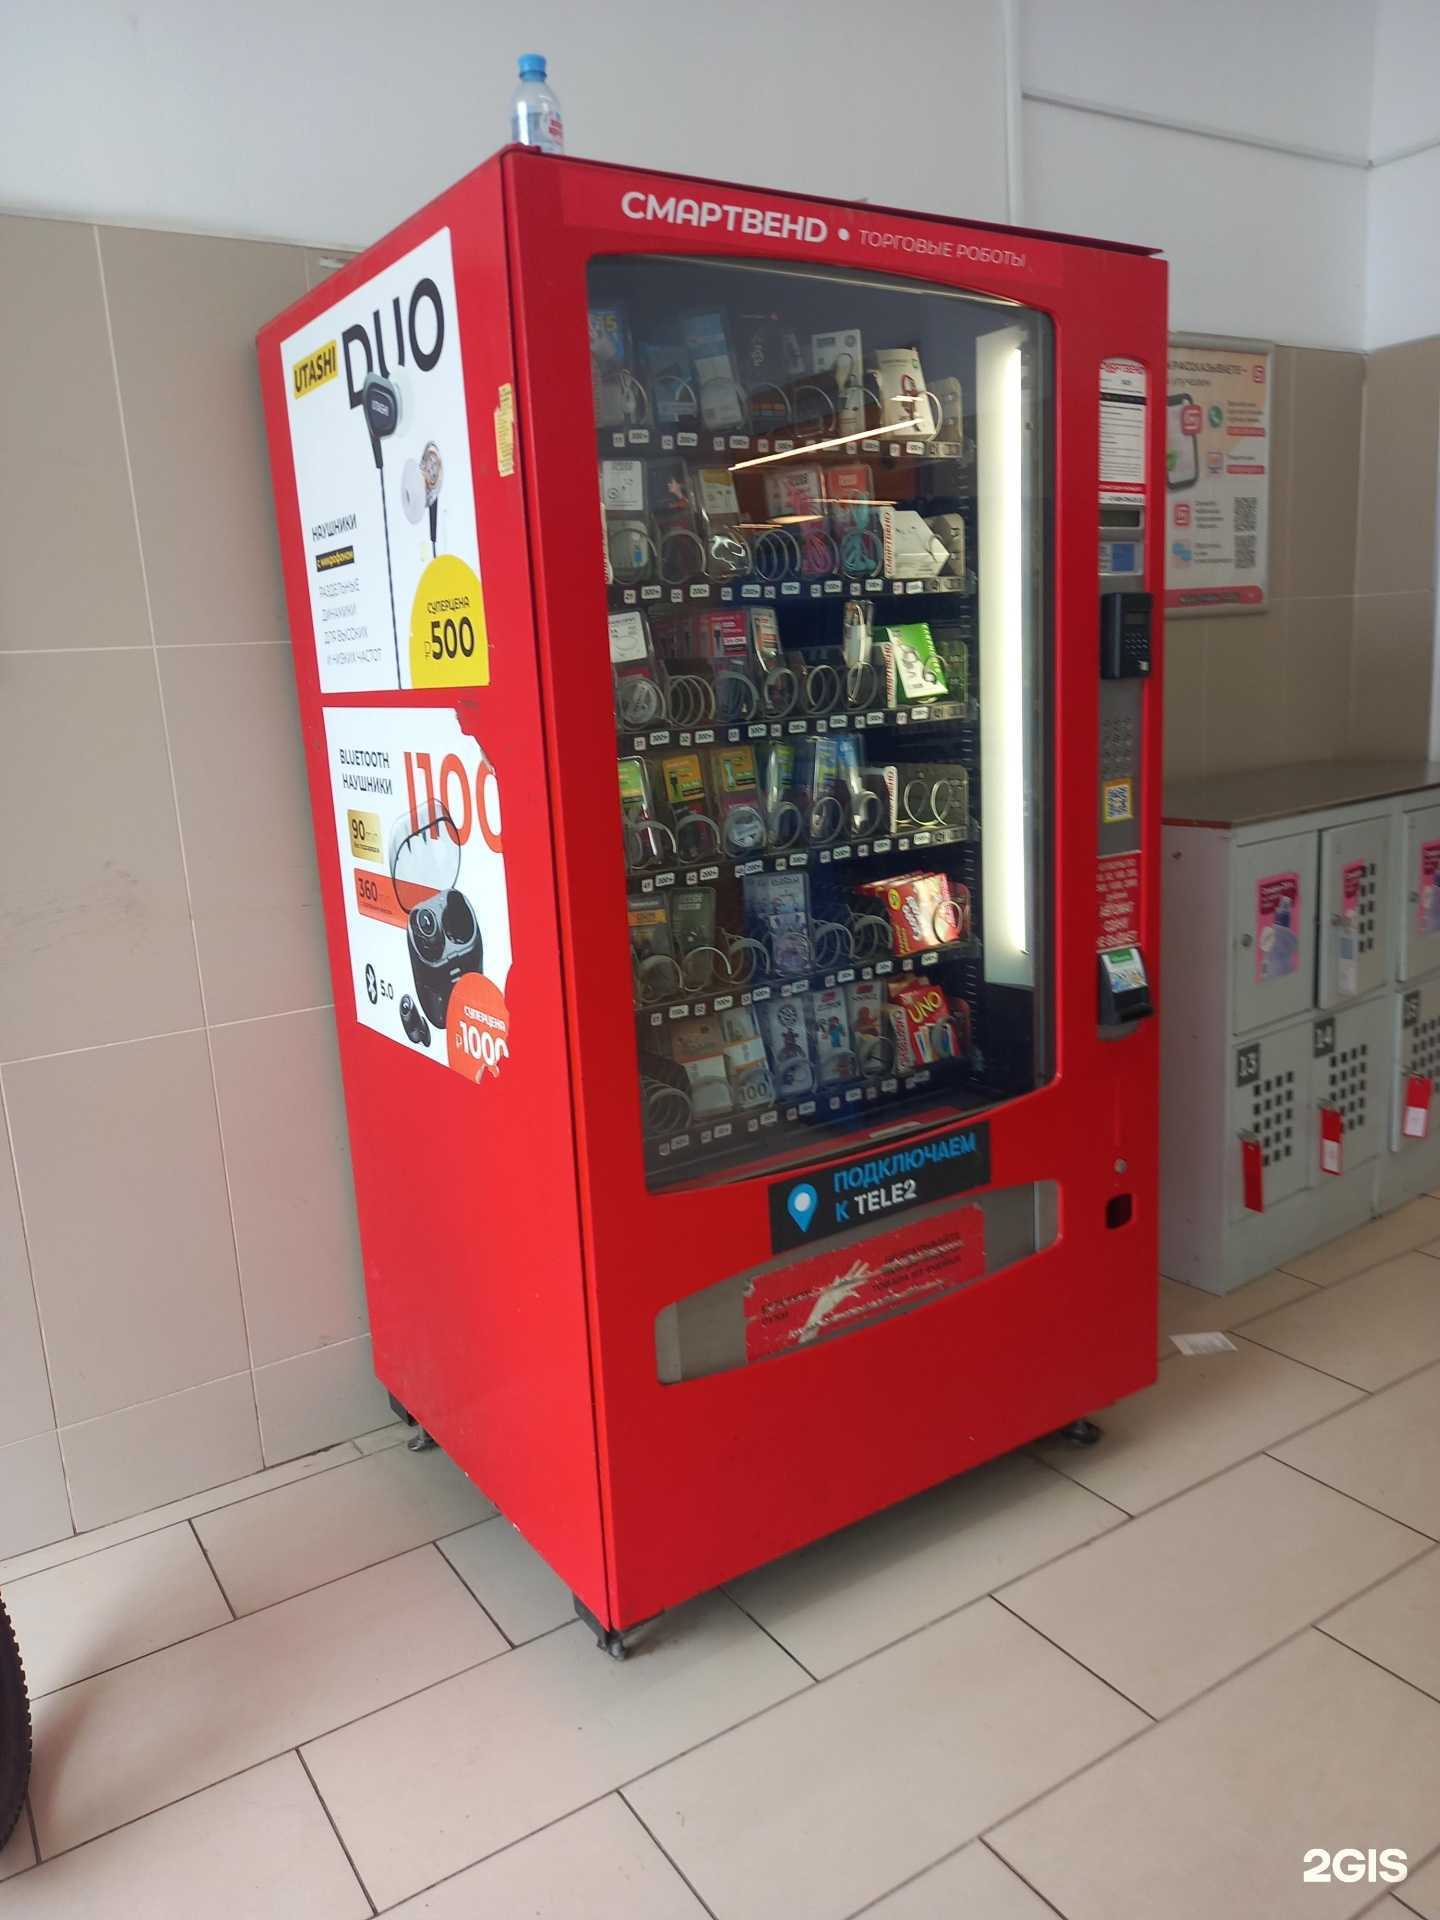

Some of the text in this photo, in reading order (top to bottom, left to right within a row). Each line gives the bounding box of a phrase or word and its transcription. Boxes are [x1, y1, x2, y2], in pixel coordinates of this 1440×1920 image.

[858, 229, 953, 257] ТОРГОВЫЕ
[956, 244, 1026, 267] РОБОТЫ
[294, 277, 444, 409] UTASHI DUO
[311, 513, 357, 542] НАУШНИКИ
[427, 595, 471, 615] СУПЕРЦЕНА
[339, 748, 391, 769] BLUETOOTH
[342, 773, 393, 795] НАУШНИКИ
[351, 818, 366, 841] 90
[357, 878, 378, 902] 360
[380, 979, 394, 1001] 5.0
[907, 991, 942, 1024] UNO
[1238, 1052, 1257, 1078] 13
[833, 1132, 977, 1193] ПОДКЛЮЧАЕМ
[834, 1179, 918, 1223] К TELE2
